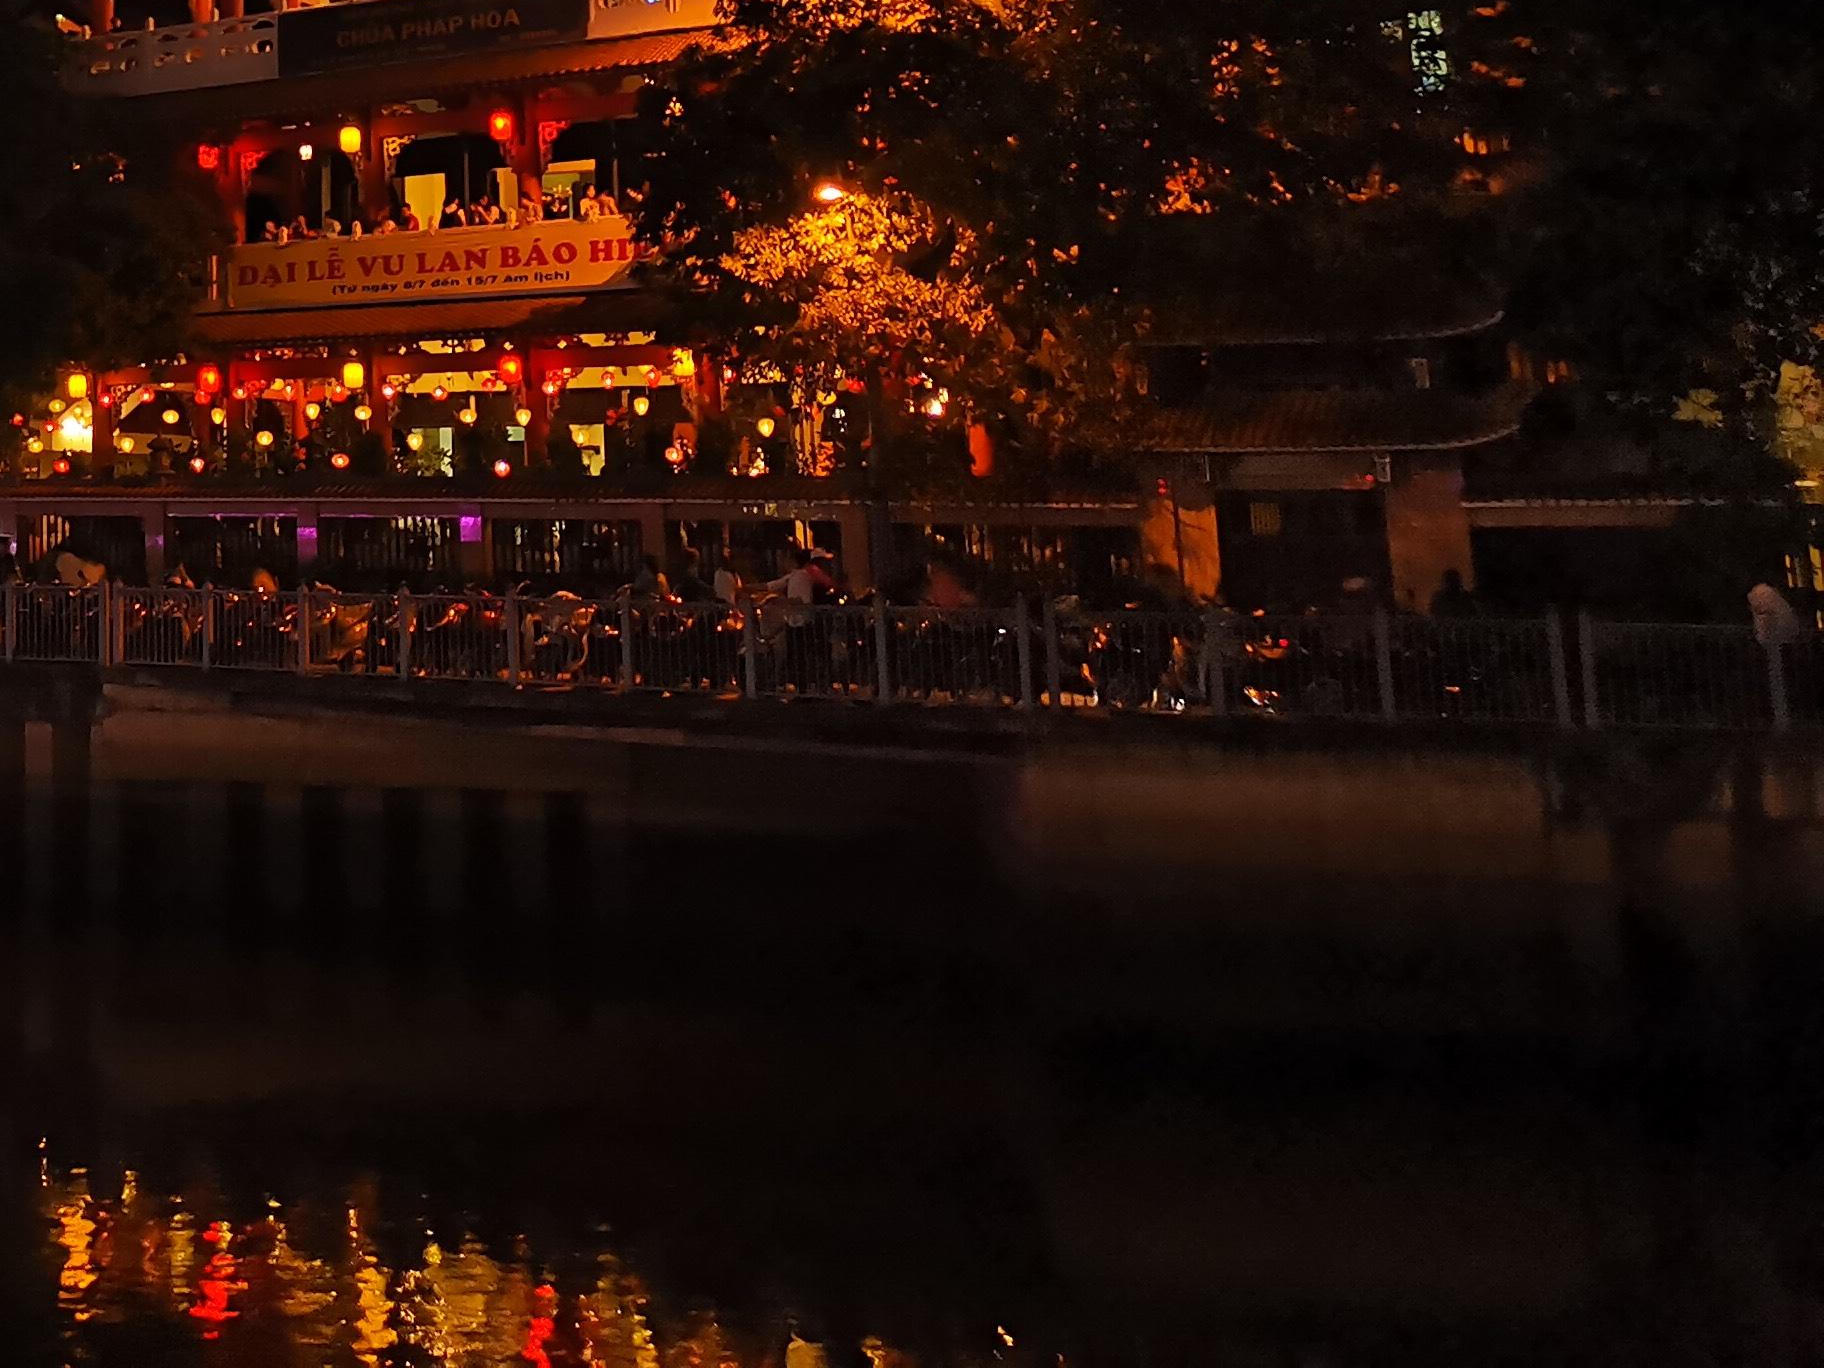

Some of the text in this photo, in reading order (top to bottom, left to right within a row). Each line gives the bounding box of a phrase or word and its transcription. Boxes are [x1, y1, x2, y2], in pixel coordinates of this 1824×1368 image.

[356, 254, 405, 277] VU
[415, 247, 490, 274] LAN
[499, 238, 578, 269] BÁO
